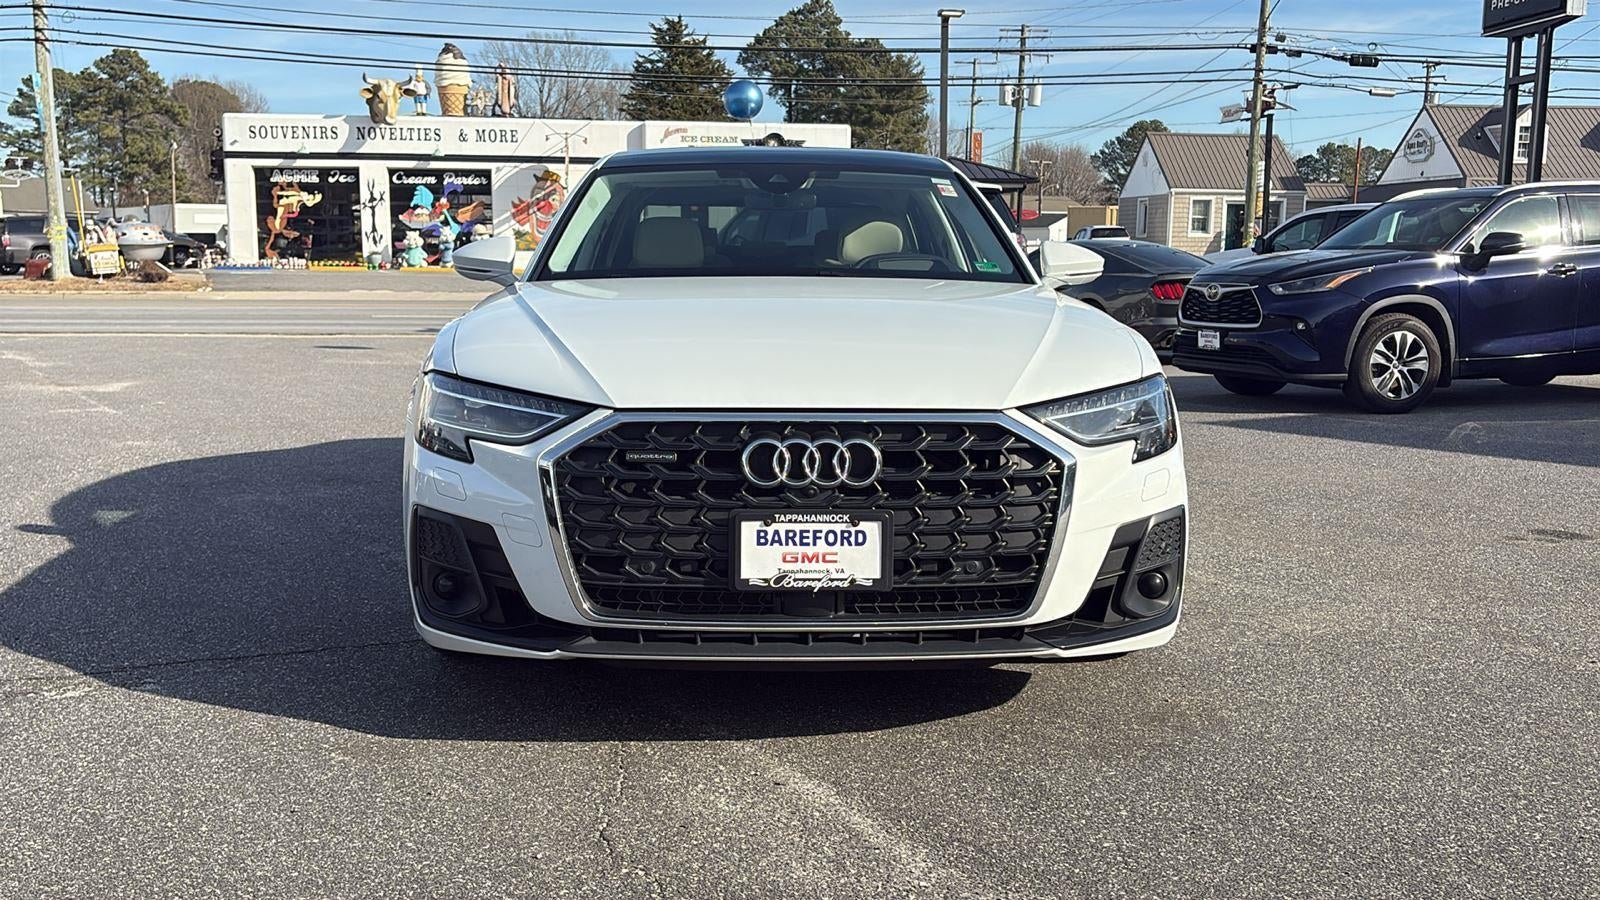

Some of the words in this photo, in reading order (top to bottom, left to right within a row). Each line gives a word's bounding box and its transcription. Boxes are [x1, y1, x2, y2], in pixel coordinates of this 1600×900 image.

[248, 125, 339, 139] SOUVENIRS
[356, 126, 441, 141] NOVELTIES
[458, 128, 469, 142] &
[475, 128, 519, 143] MORE
[680, 135, 698, 143] ICE
[700, 135, 739, 143] CREAM
[270, 169, 320, 183] ACME
[327, 169, 357, 183] Ice
[391, 171, 438, 184] Cream
[442, 172, 489, 185] Parlor
[774, 514, 850, 523] TAPPAHANNOCK
[756, 529, 867, 547] BAREFORD
[782, 552, 838, 564] GMC
[777, 568, 833, 576] Tappahannock,
[769, 573, 855, 593] Bareford
